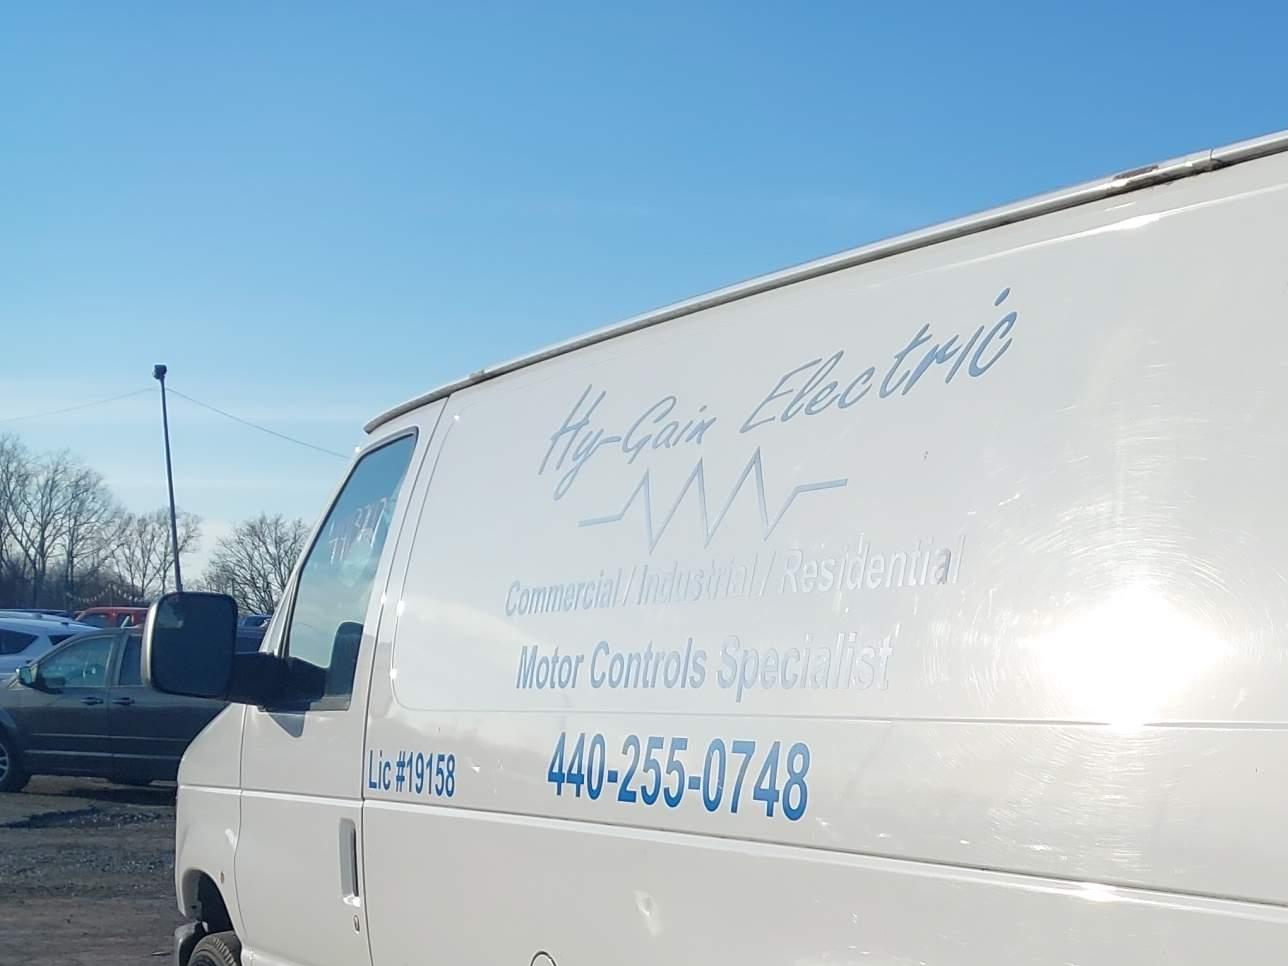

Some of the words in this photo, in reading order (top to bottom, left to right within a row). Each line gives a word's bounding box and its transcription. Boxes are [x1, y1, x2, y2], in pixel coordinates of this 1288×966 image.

[538, 384, 717, 501] Hy-Gain
[739, 288, 1017, 433] Electric
[504, 565, 620, 616] Commercial
[637, 552, 760, 606] Industrial
[782, 534, 966, 595] Residential
[515, 643, 585, 690] Motor
[589, 636, 708, 689] Controls
[717, 632, 894, 703] Specialist
[368, 749, 392, 791] Lic
[395, 750, 456, 798] #19158
[547, 731, 811, 821] 440-255-0748
